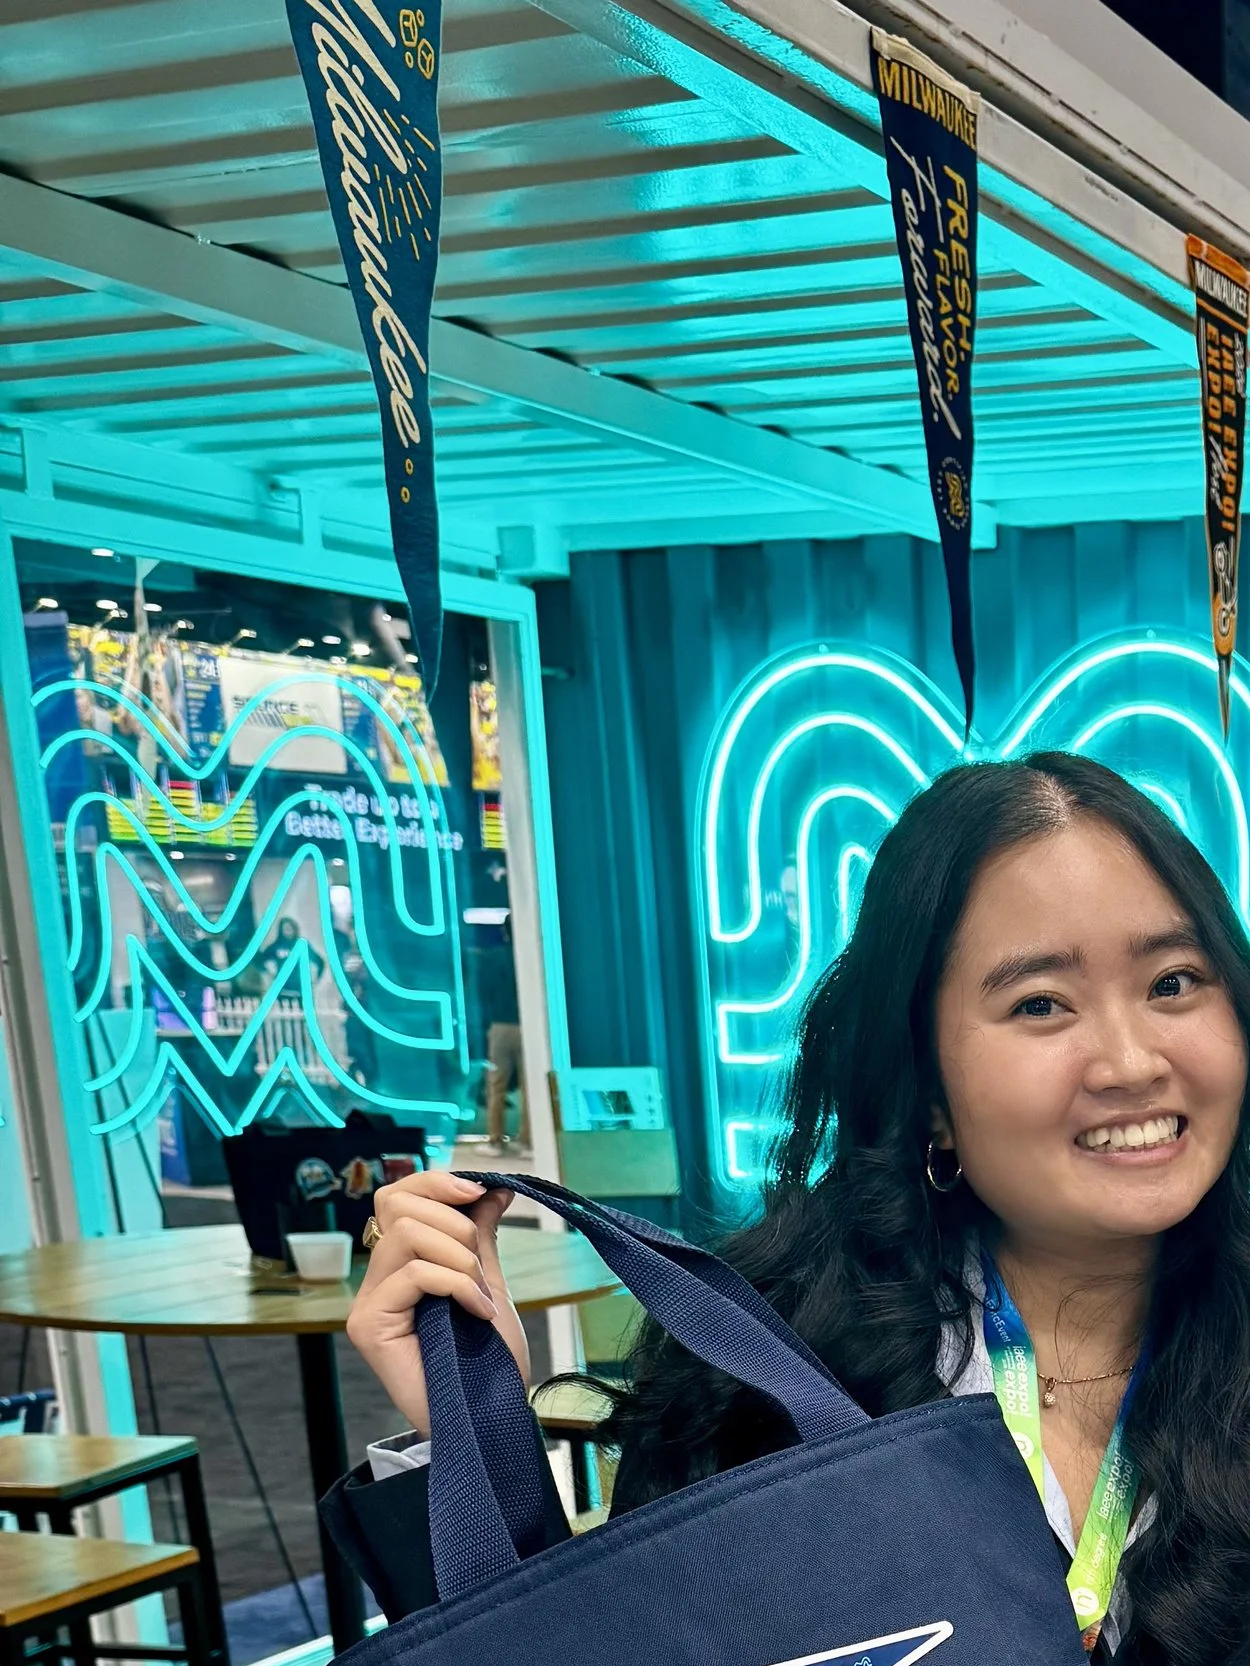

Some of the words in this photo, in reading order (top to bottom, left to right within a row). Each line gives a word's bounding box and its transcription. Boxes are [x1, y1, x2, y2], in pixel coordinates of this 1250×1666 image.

[877, 56, 978, 153] MILWAUKEE
[890, 136, 962, 440] Forward.
[933, 248, 961, 401] FLAVOR.
[943, 165, 973, 362] FRESH.
[1194, 260, 1249, 319] MILWAUKEE
[285, 810, 346, 841] Bette
